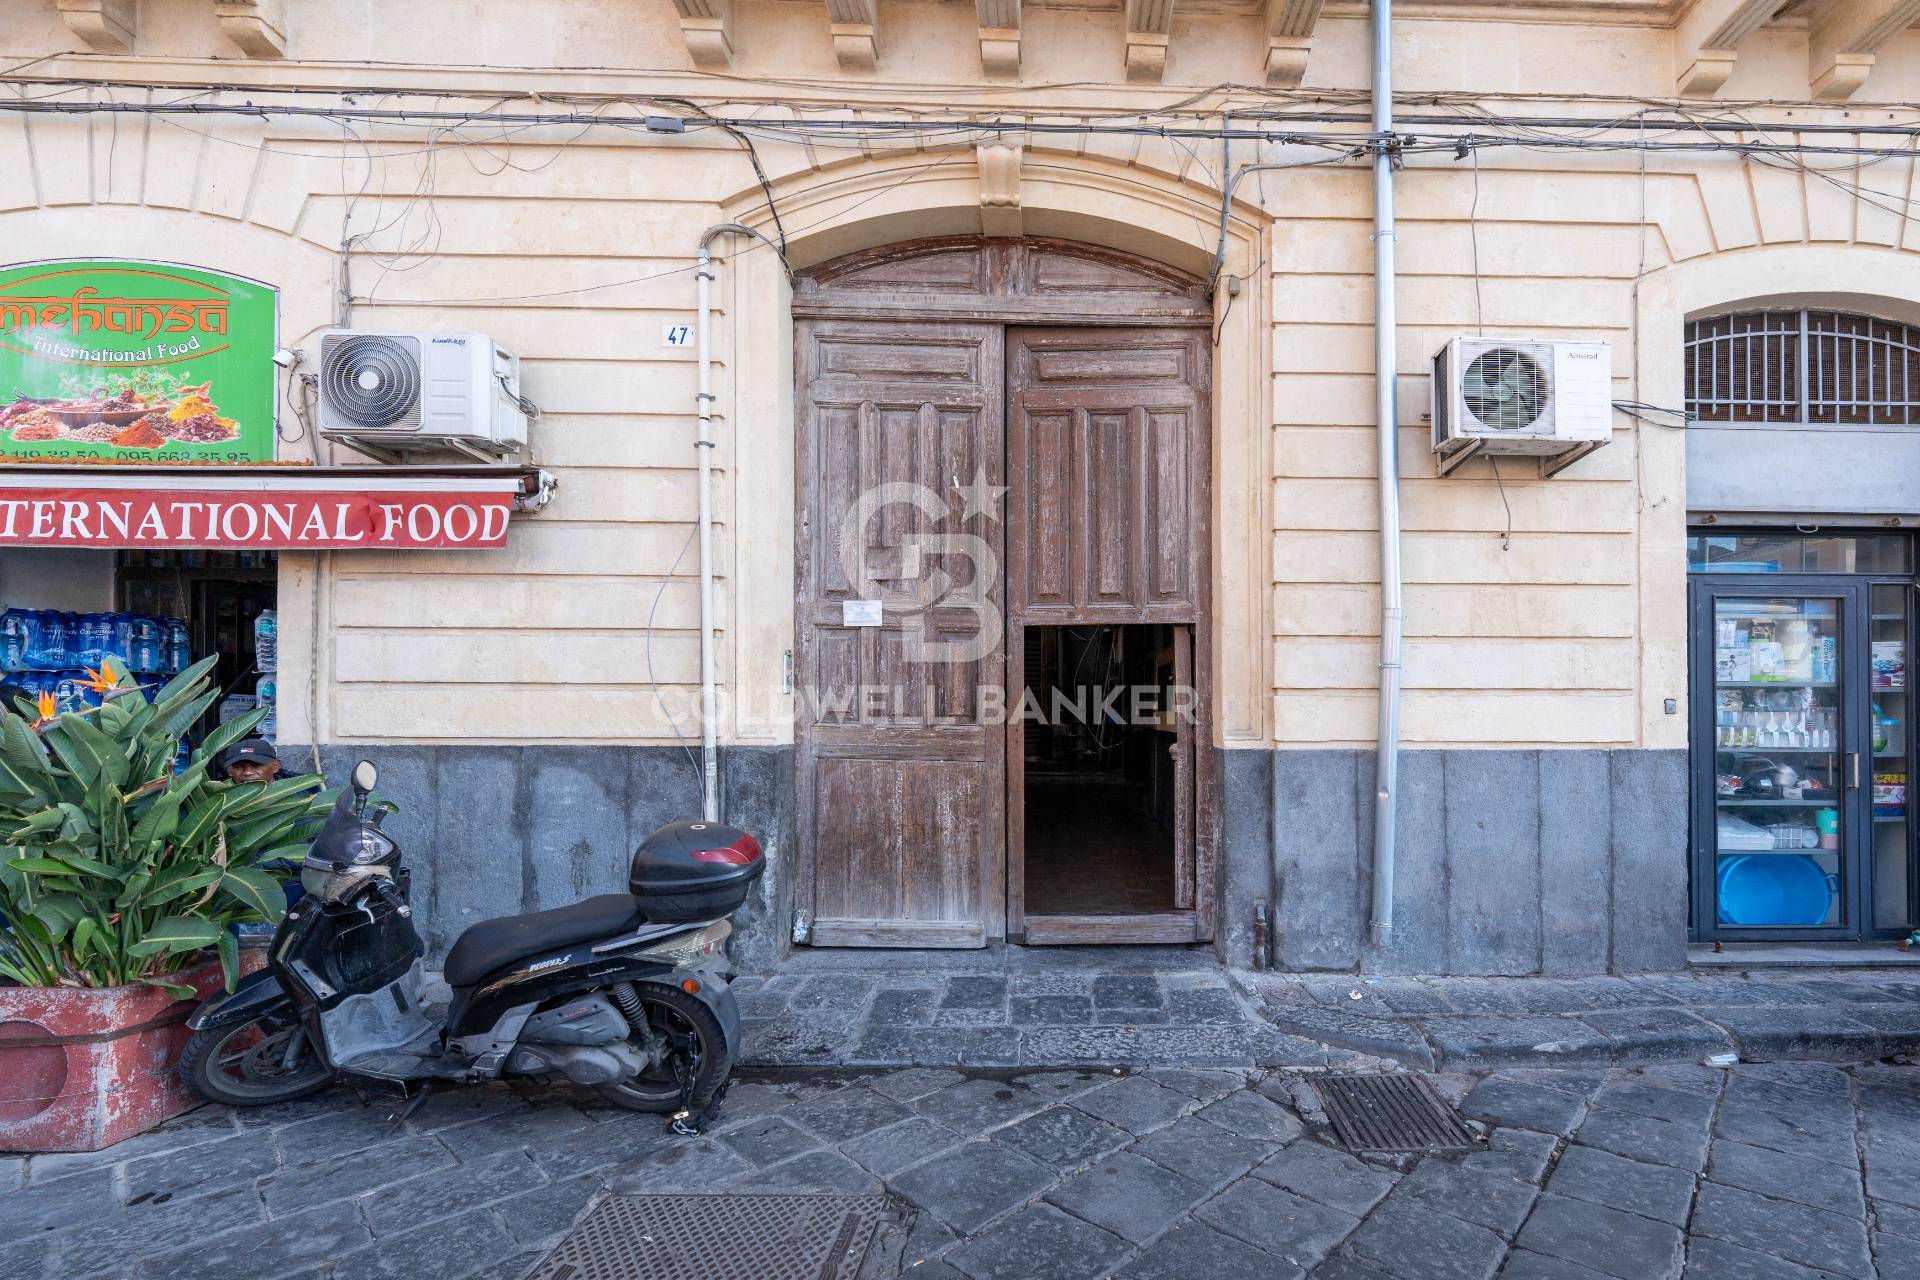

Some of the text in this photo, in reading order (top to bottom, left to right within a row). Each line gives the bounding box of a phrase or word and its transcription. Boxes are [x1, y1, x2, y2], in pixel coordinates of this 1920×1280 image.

[33, 335, 201, 362] International Food
[668, 327, 688, 344] 47
[0, 500, 511, 542] TERNATIONAL FOOD
